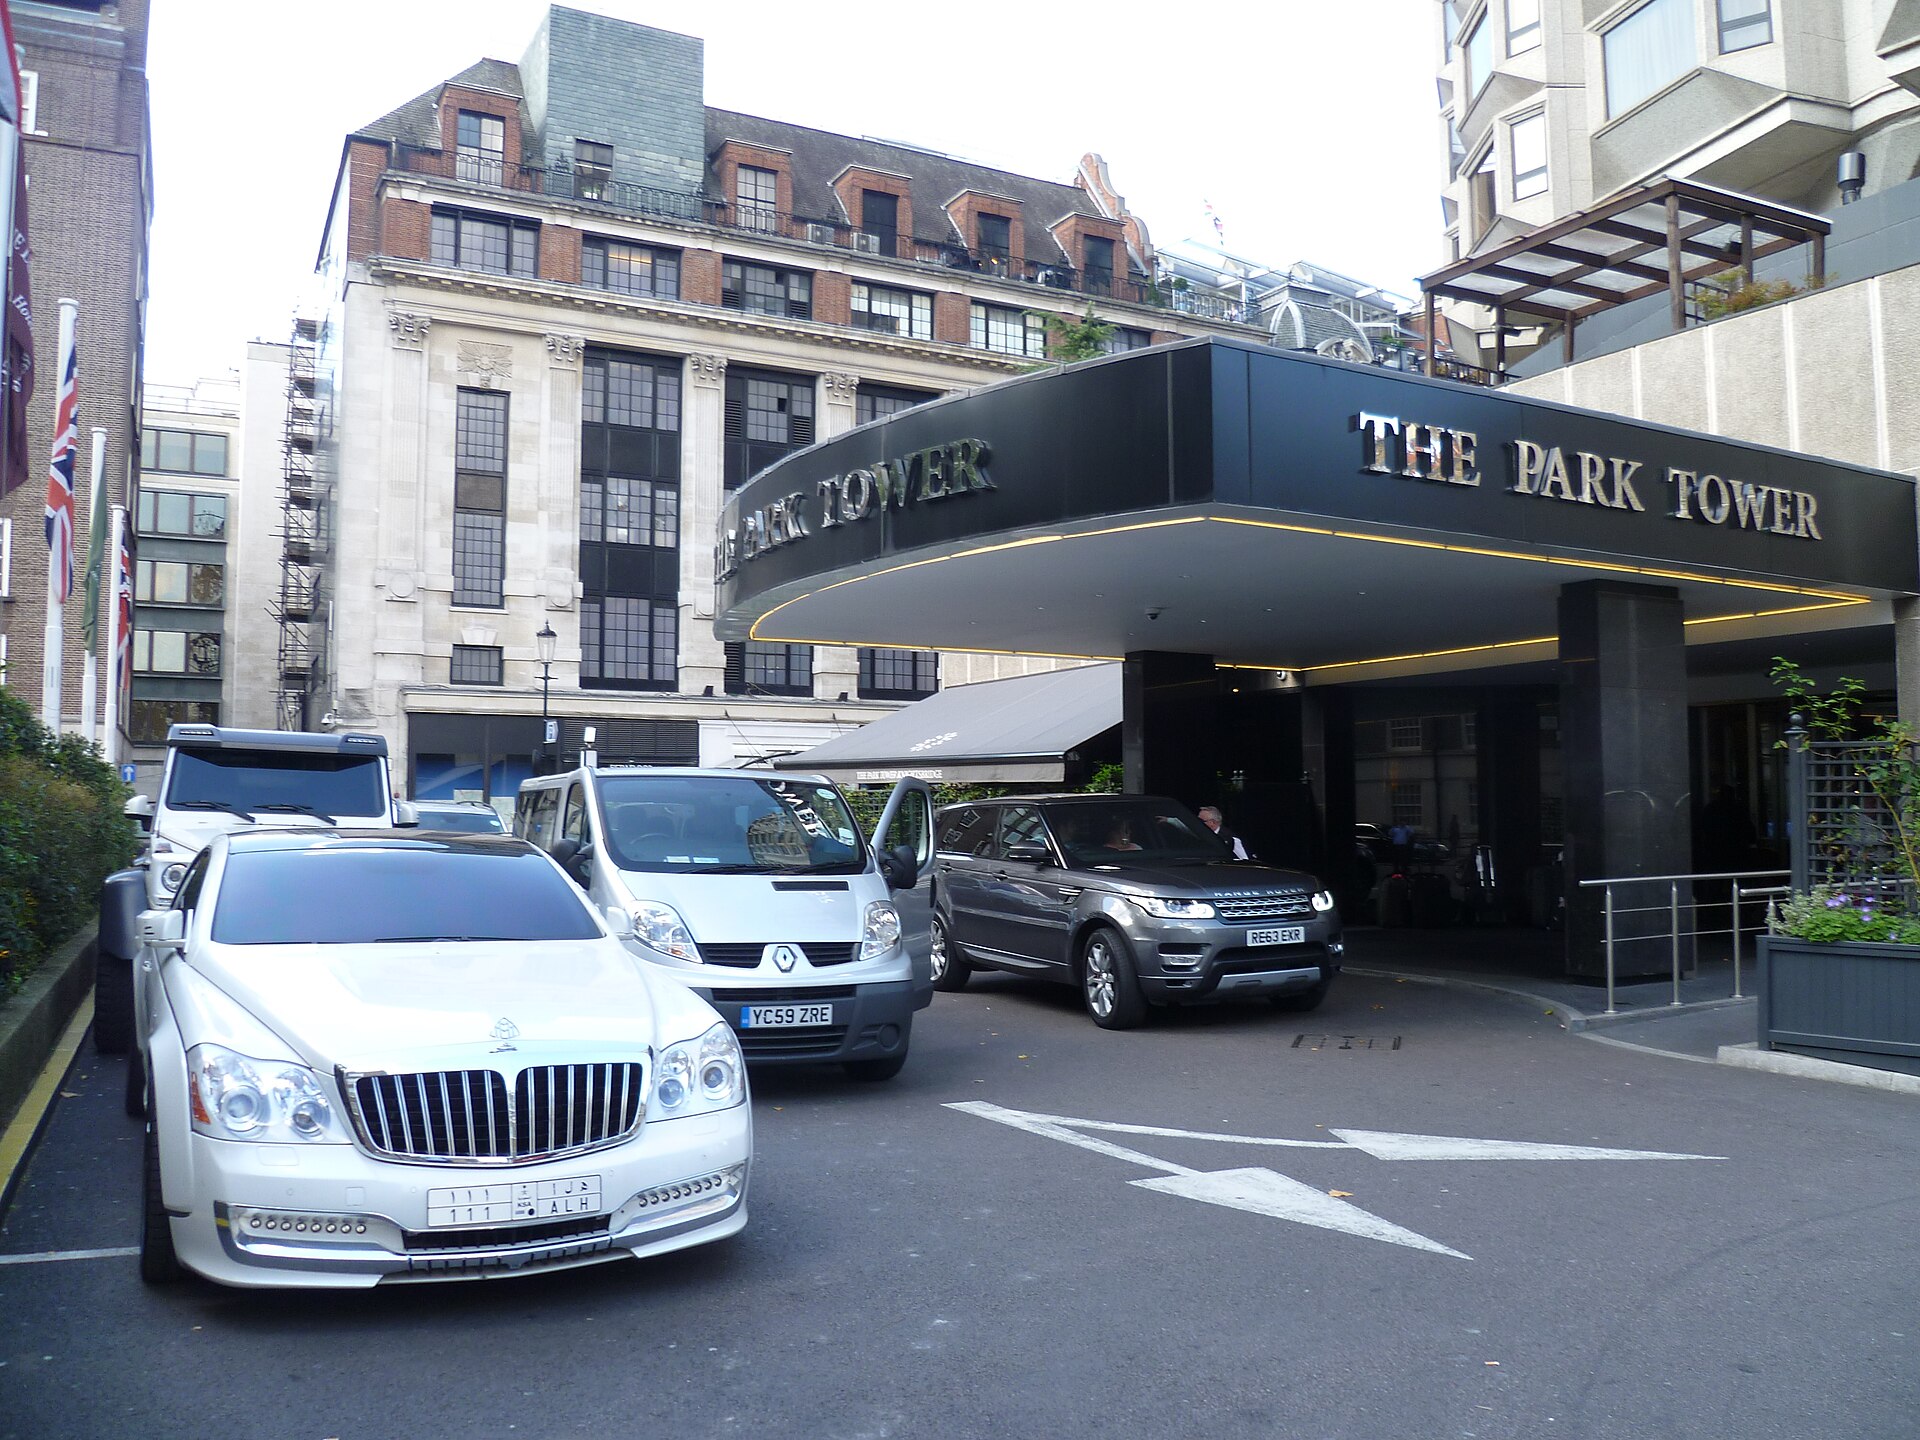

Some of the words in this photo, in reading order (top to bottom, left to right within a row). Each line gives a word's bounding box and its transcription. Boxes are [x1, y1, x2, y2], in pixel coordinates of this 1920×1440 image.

[743, 491, 810, 560] PARK
[817, 437, 998, 529] TOWER
[1359, 411, 1481, 488] THE
[1511, 439, 1645, 513] PARK
[1665, 466, 1823, 541] TOWER
[1251, 929, 1279, 944] RE63
[1281, 928, 1301, 942] EXR
[753, 1008, 795, 1024] YC59
[799, 1006, 830, 1023] ZRE
